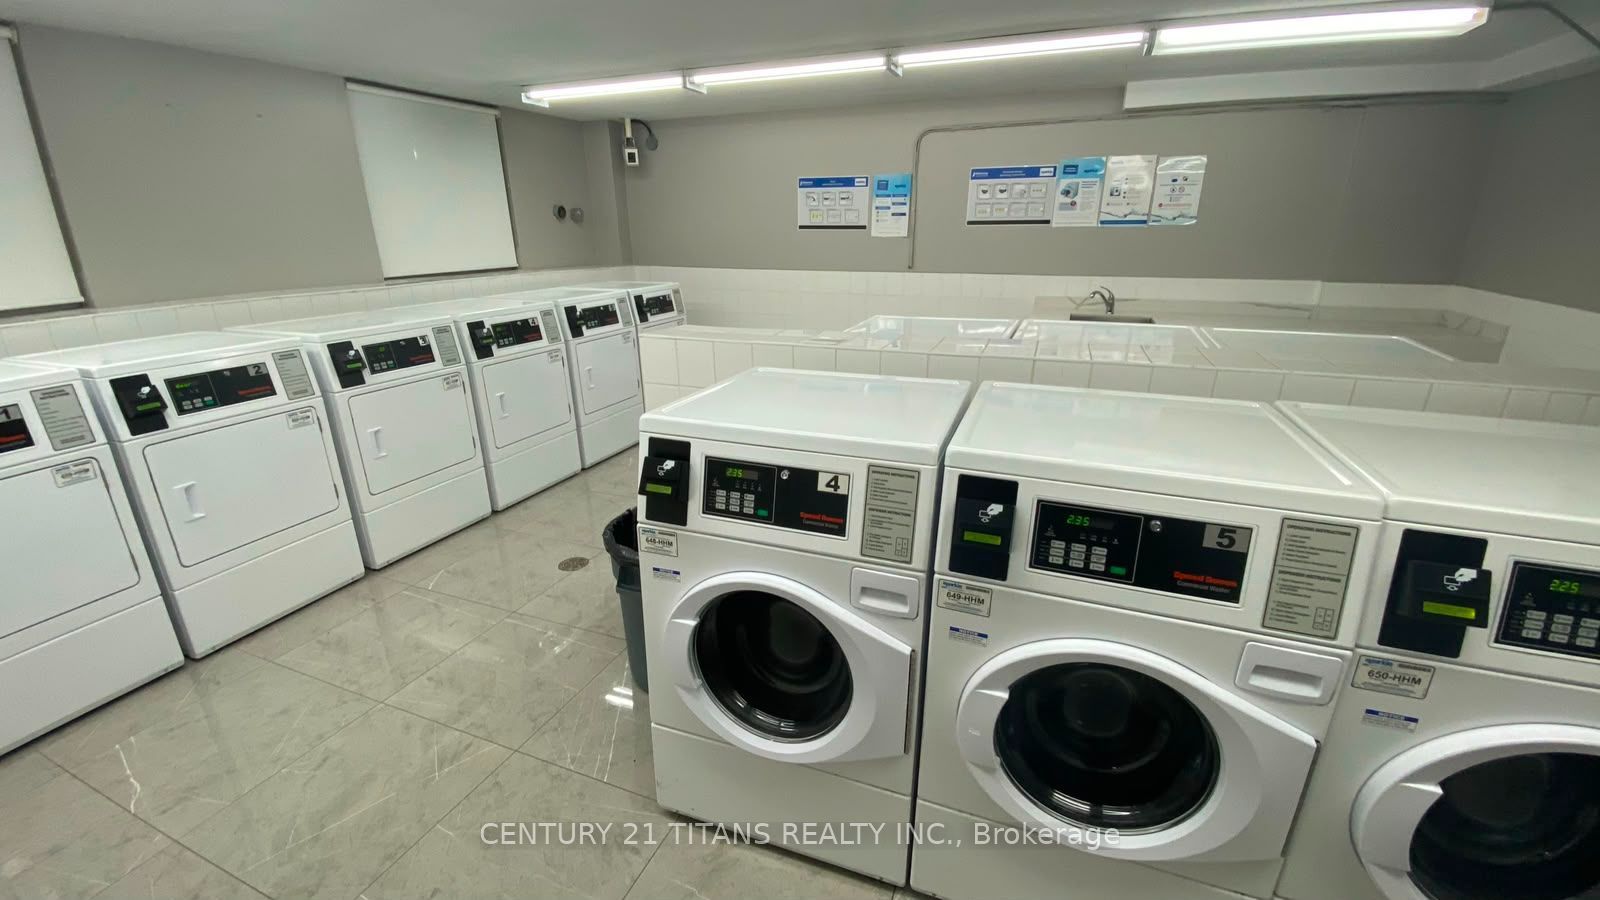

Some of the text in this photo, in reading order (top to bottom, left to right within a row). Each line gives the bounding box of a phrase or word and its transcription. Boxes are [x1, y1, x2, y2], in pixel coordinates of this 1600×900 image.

[252, 364, 264, 376] 2
[0, 408, 11, 420] 1
[825, 475, 840, 492] 4
[1215, 527, 1235, 549] 5
[946, 591, 985, 605] 649-HHM
[1367, 669, 1421, 685] 650-HHM
